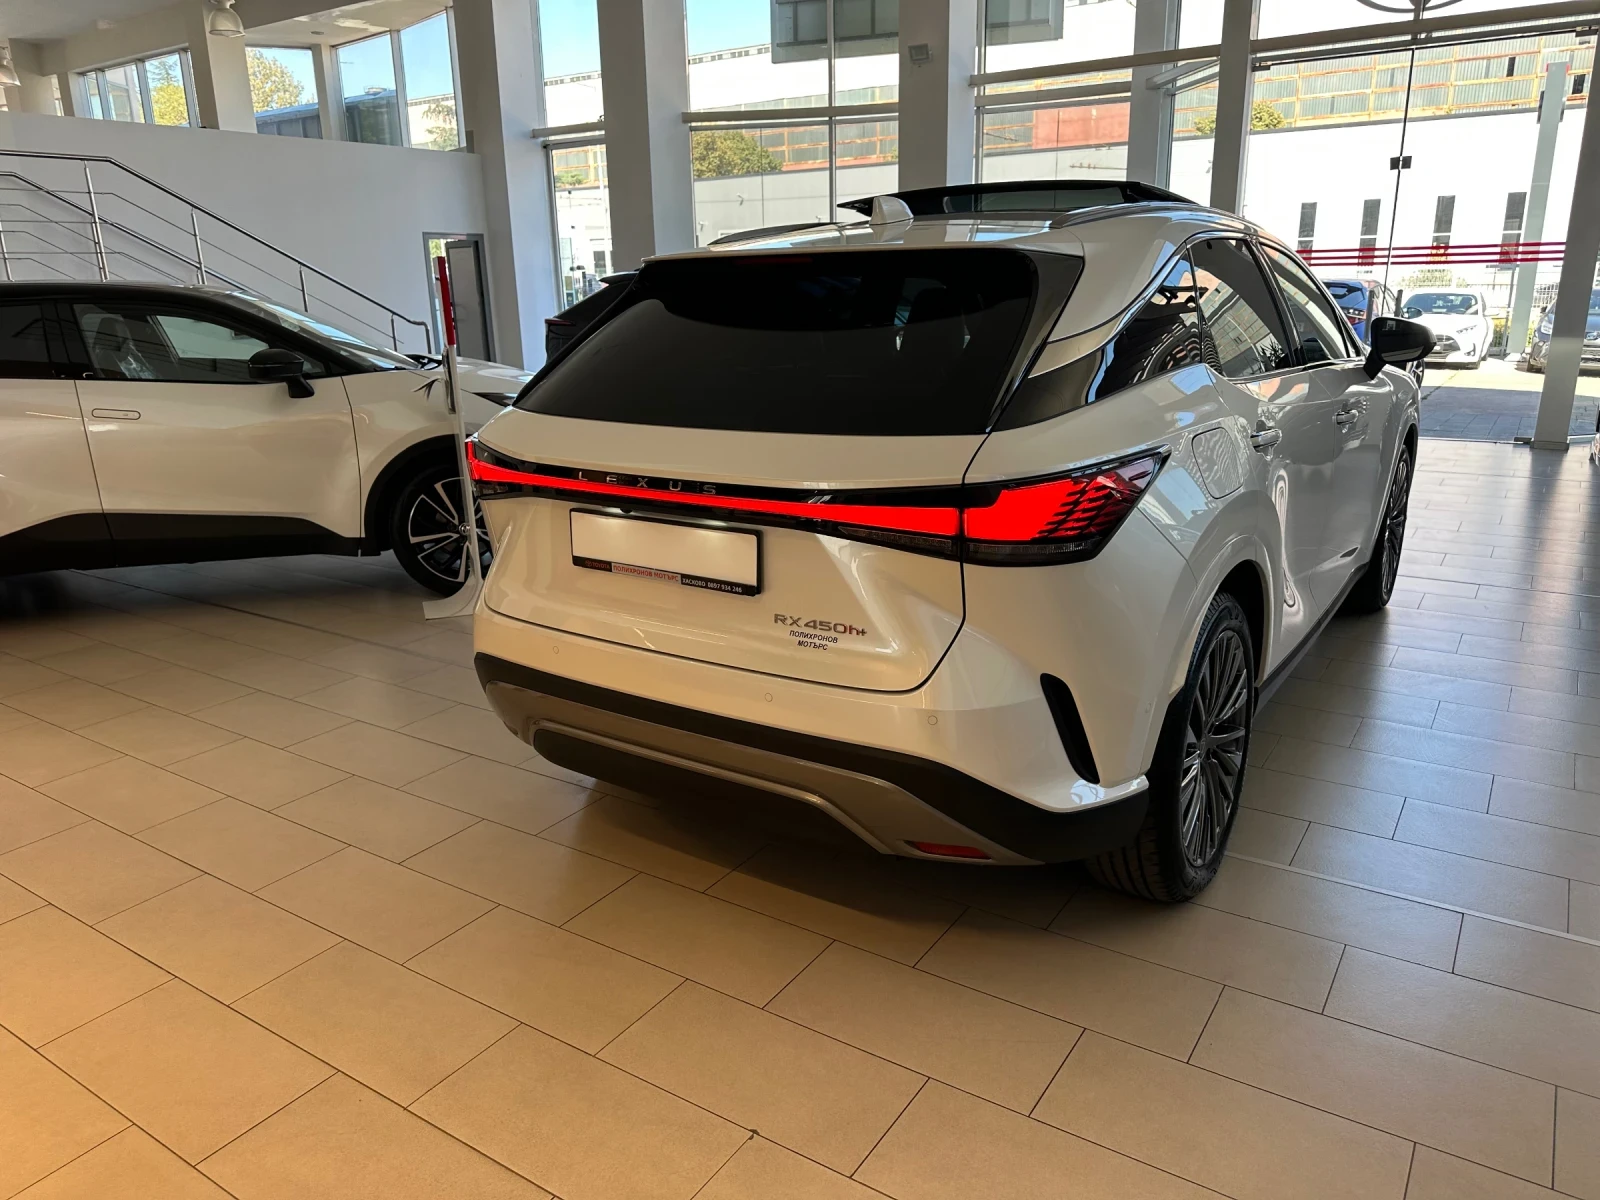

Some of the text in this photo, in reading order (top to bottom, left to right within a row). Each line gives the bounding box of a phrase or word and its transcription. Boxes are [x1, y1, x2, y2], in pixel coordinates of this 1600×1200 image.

[578, 471, 716, 495] LEXUS
[613, 565, 679, 582] ПОЛИХРОНОВ МОТЪРС
[682, 578, 706, 587] ХАСКОВО
[789, 630, 838, 643] ПОЛИХРОНОВ
[797, 640, 828, 650] МОТЪРС
